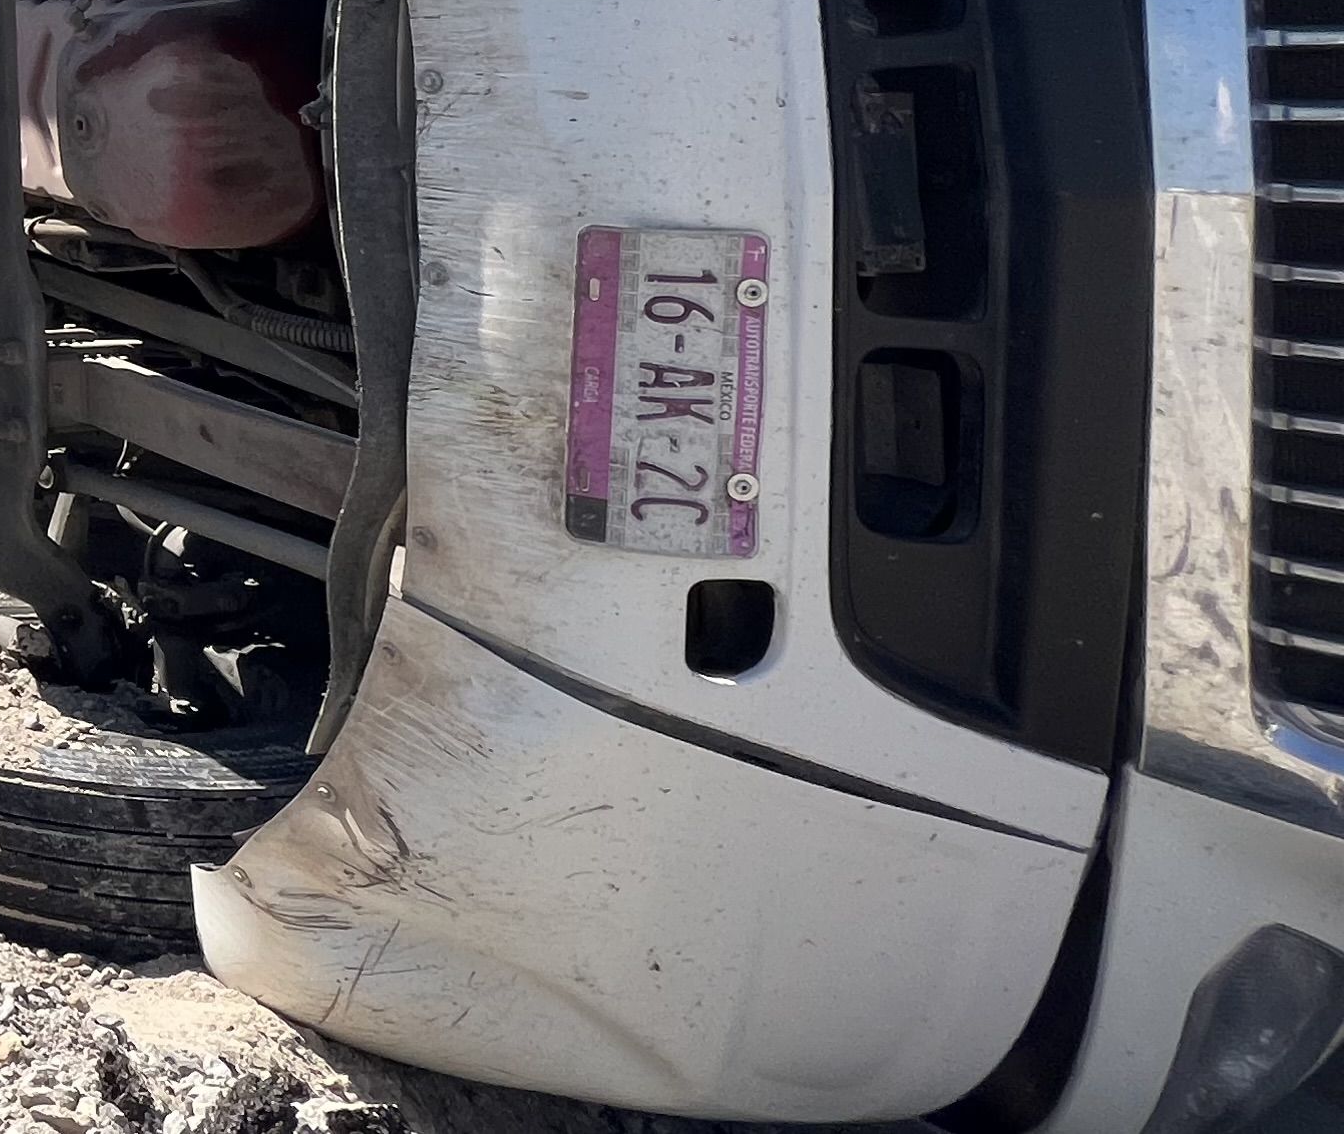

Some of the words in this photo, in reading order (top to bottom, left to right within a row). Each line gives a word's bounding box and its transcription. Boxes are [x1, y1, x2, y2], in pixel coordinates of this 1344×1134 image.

[583, 366, 600, 403] CARGA
[742, 315, 761, 425] AUTOTRANSPORTE
[630, 269, 718, 525] 16-AK-2C
[719, 371, 737, 421] MÉXICO
[738, 426, 757, 471] FEDERA
